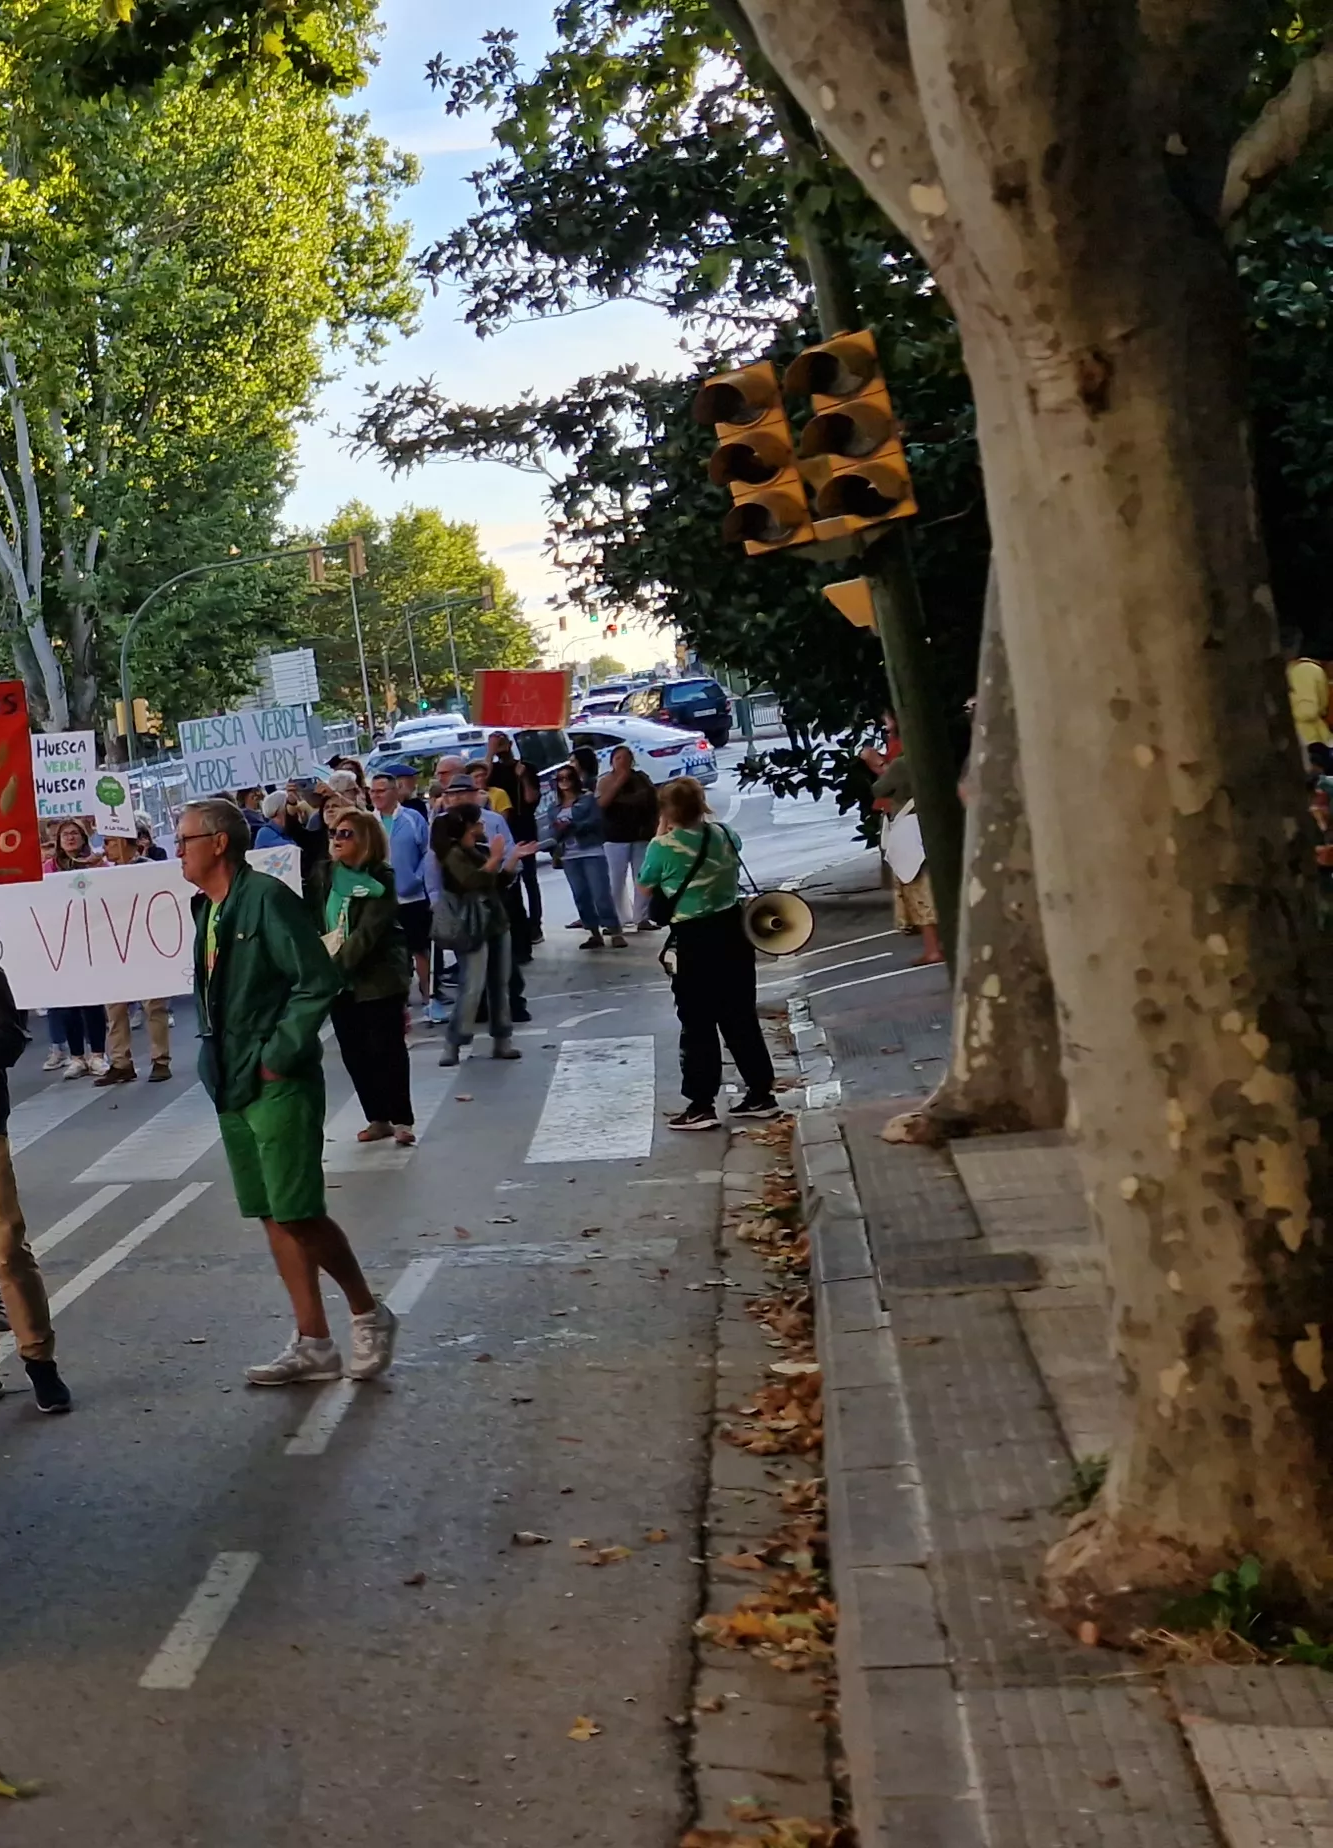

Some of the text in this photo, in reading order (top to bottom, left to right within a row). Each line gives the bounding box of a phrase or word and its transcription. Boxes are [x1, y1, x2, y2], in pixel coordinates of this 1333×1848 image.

[182, 705, 308, 754] HUESCA VERDE
[36, 739, 87, 758] HUESCA
[251, 744, 309, 782] VERDE
[35, 777, 86, 795] HUESCA
[38, 799, 83, 815] FUERTE
